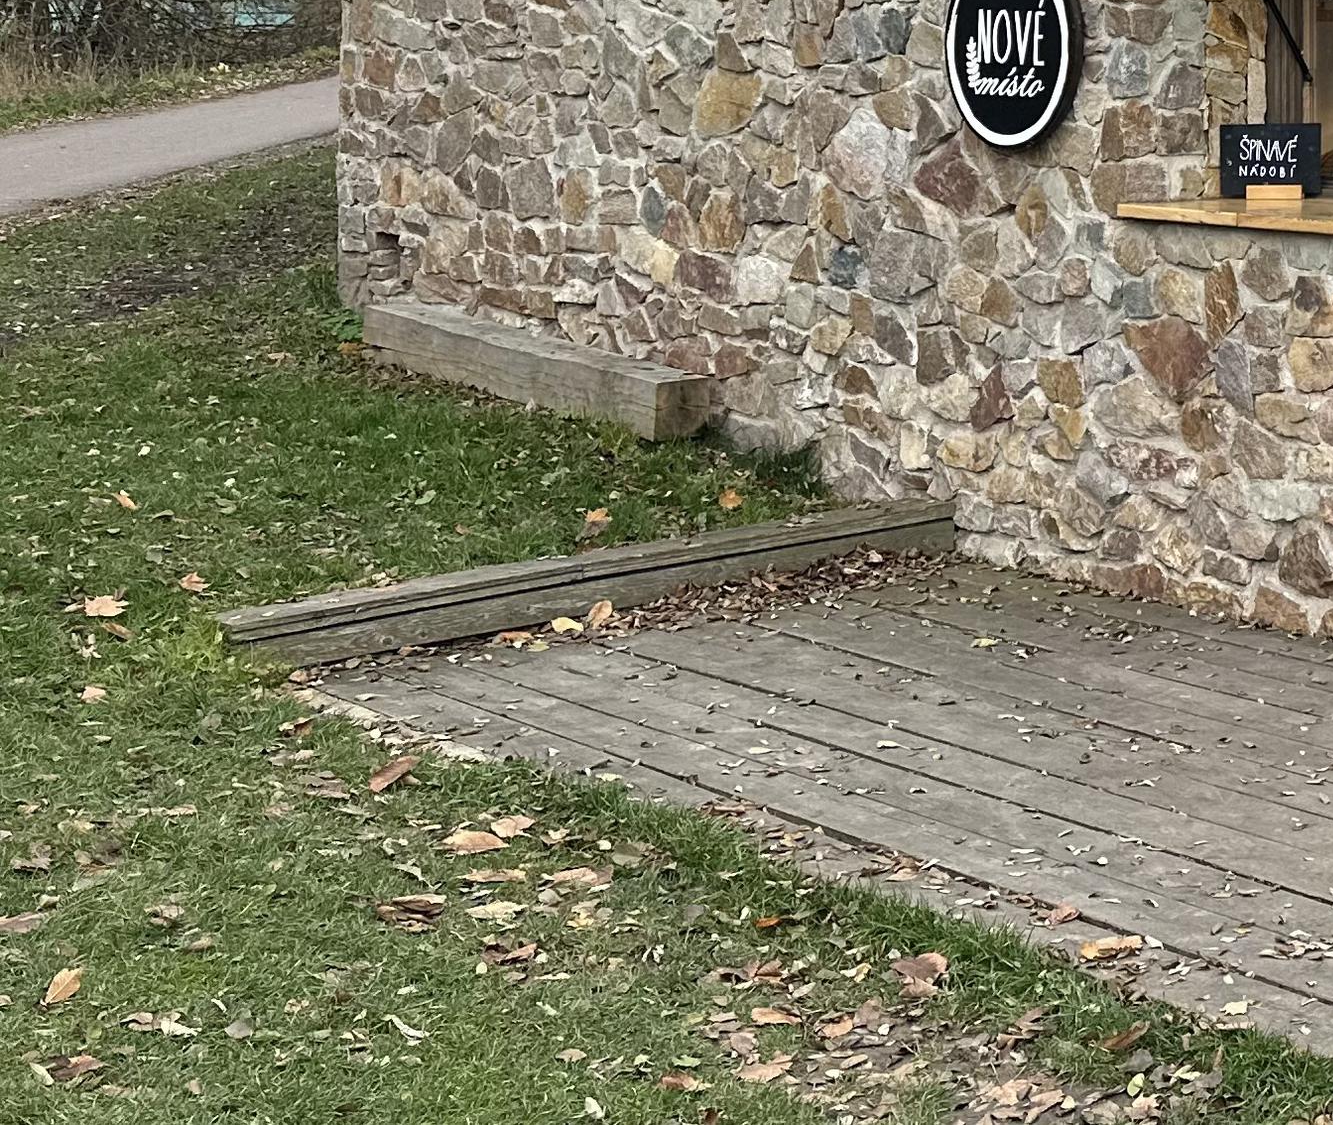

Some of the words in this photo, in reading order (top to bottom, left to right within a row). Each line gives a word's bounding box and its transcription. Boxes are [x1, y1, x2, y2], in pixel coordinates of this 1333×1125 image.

[975, 66, 1045, 98] místo
[1239, 134, 1299, 163] ŠPINAVÉ
[1238, 163, 1297, 179] NÁDOBÍ
